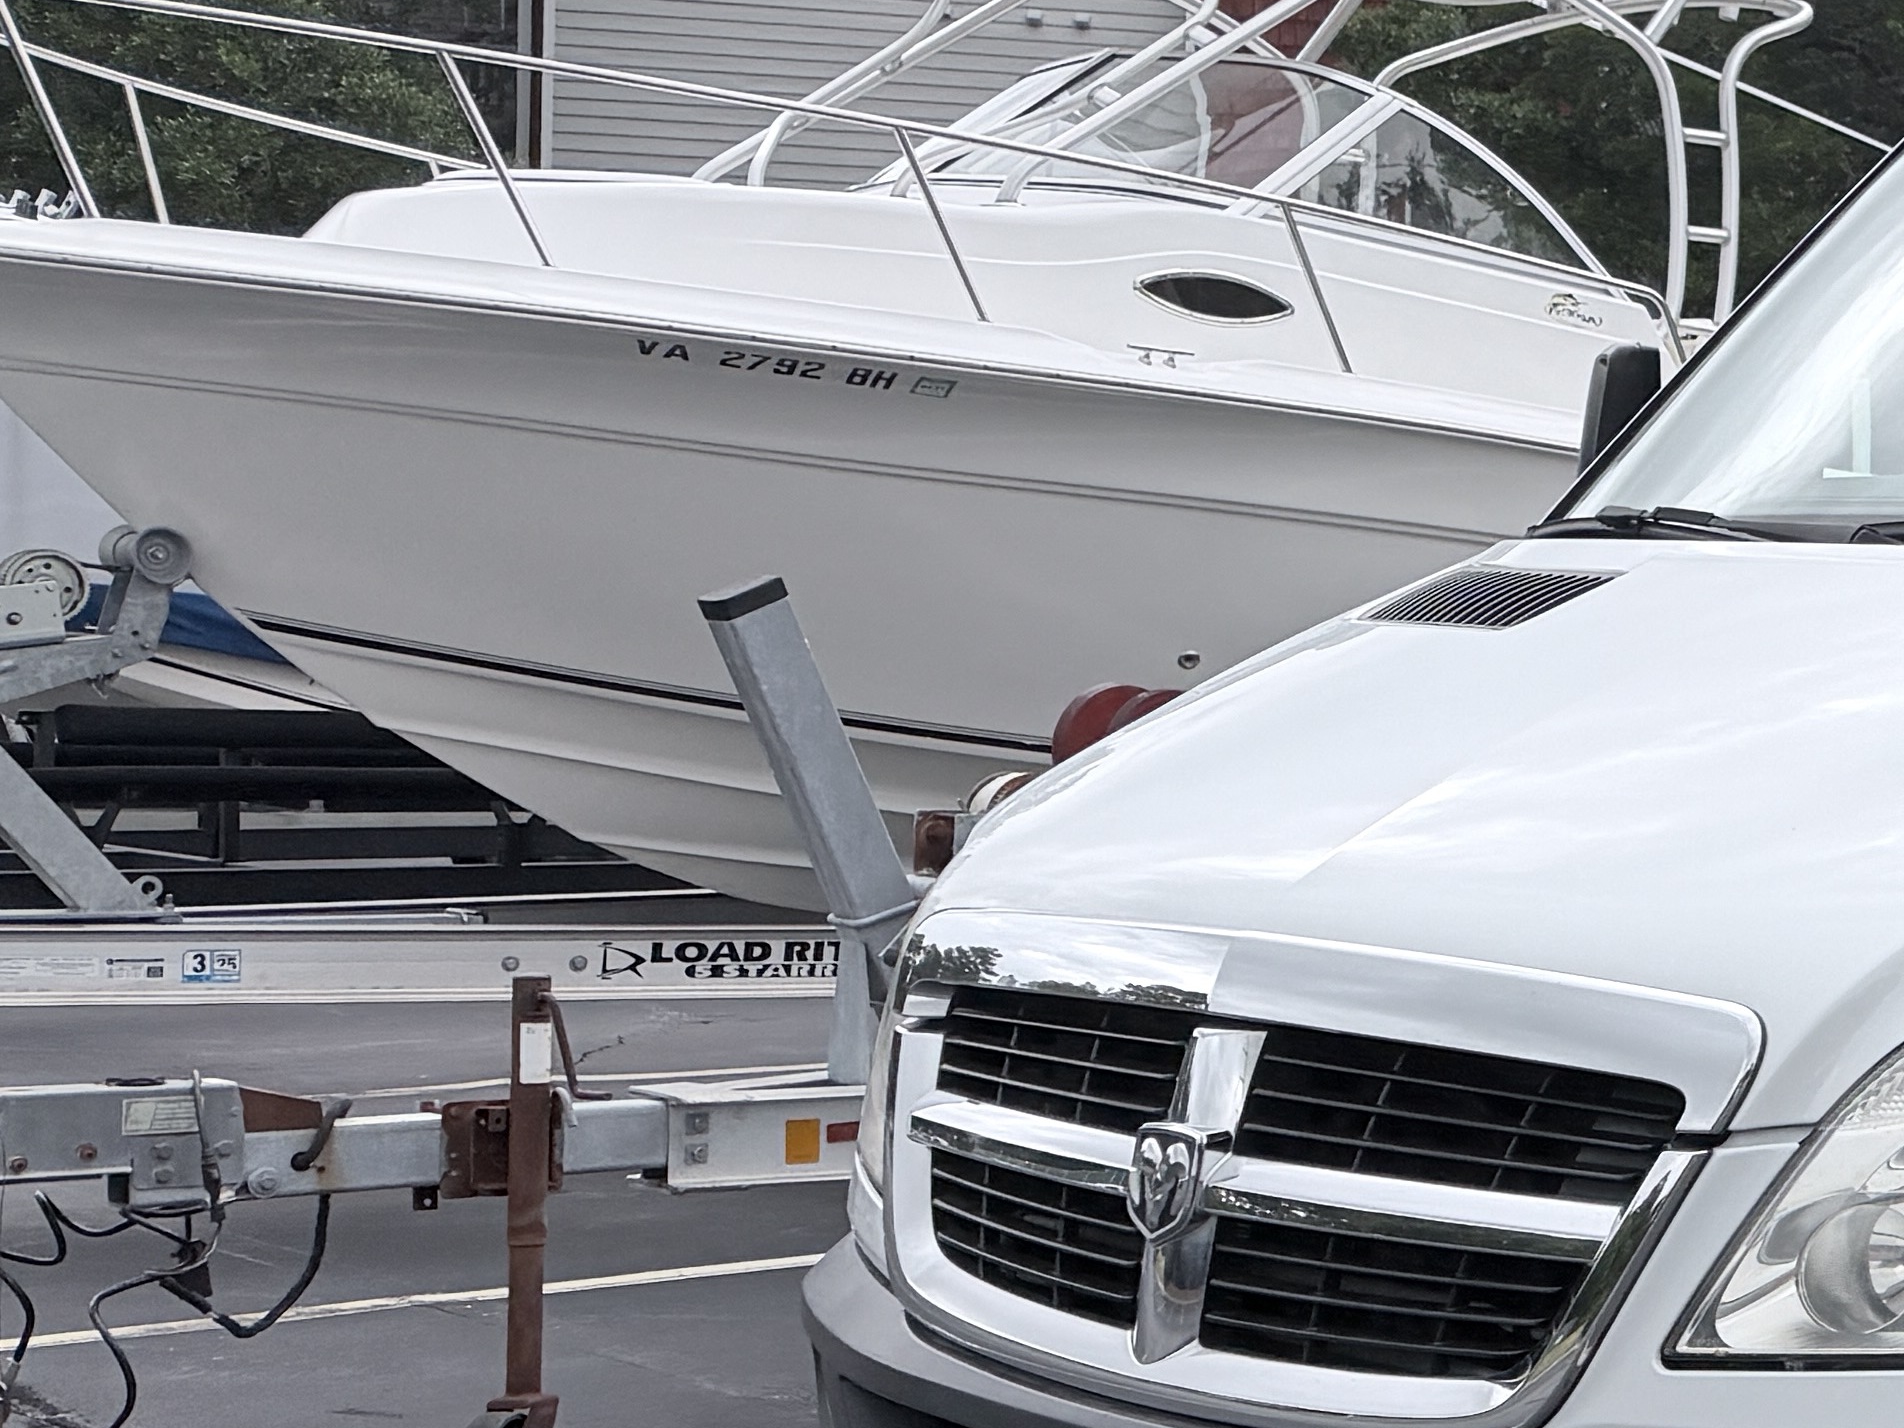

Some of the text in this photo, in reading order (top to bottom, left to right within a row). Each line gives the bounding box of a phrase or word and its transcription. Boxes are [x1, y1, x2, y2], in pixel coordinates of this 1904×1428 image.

[637, 339, 690, 361] VA
[719, 350, 826, 379] 2792
[650, 942, 772, 963] LOAD
[193, 953, 206, 974] 3
